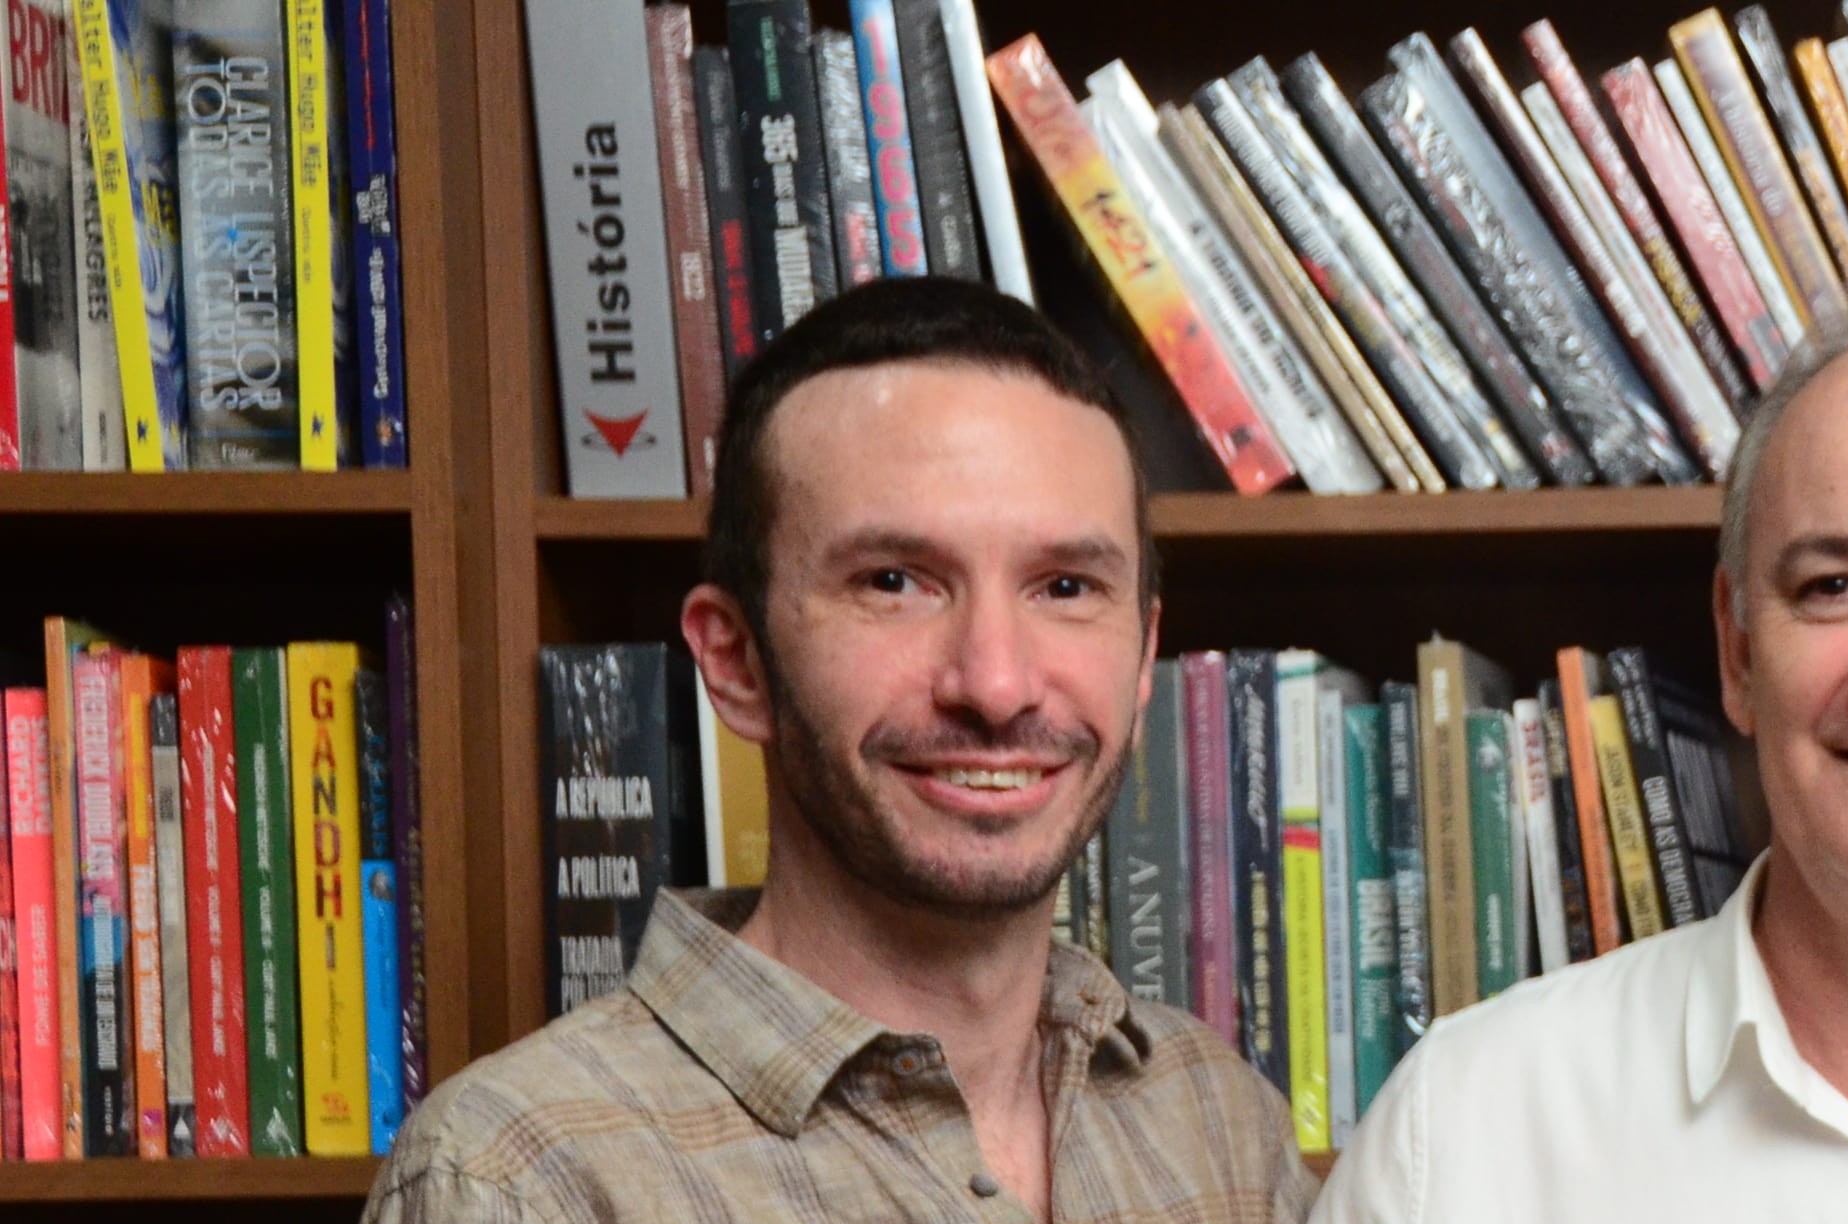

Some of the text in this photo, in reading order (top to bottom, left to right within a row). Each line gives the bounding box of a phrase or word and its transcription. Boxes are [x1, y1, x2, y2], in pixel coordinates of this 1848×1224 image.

[88, 79, 122, 193] Hugo Mãe
[296, 73, 318, 133] Hugo
[759, 112, 799, 163] 365
[865, 16, 921, 268] 1965
[301, 145, 323, 187] Mãe
[183, 60, 240, 412] TODAS AS CARTAS
[222, 56, 283, 410] CLARICE LISPECTOR
[586, 122, 637, 384] História
[77, 674, 111, 779] FREDERICK
[1520, 719, 1550, 807] BRASIL
[4, 713, 34, 837] RICHARD
[555, 776, 653, 819] A REPÚBLICA
[1639, 772, 1678, 827] COMO
[82, 781, 115, 883] DOUGLASS
[306, 676, 347, 971] GANDHI
[1652, 822, 1679, 849] AS
[132, 861, 156, 934] FREUD
[557, 853, 641, 898] A POLÍTICA
[1124, 851, 1160, 887] A
[28, 901, 50, 990] DE SABER
[1355, 877, 1396, 971] BRASIL
